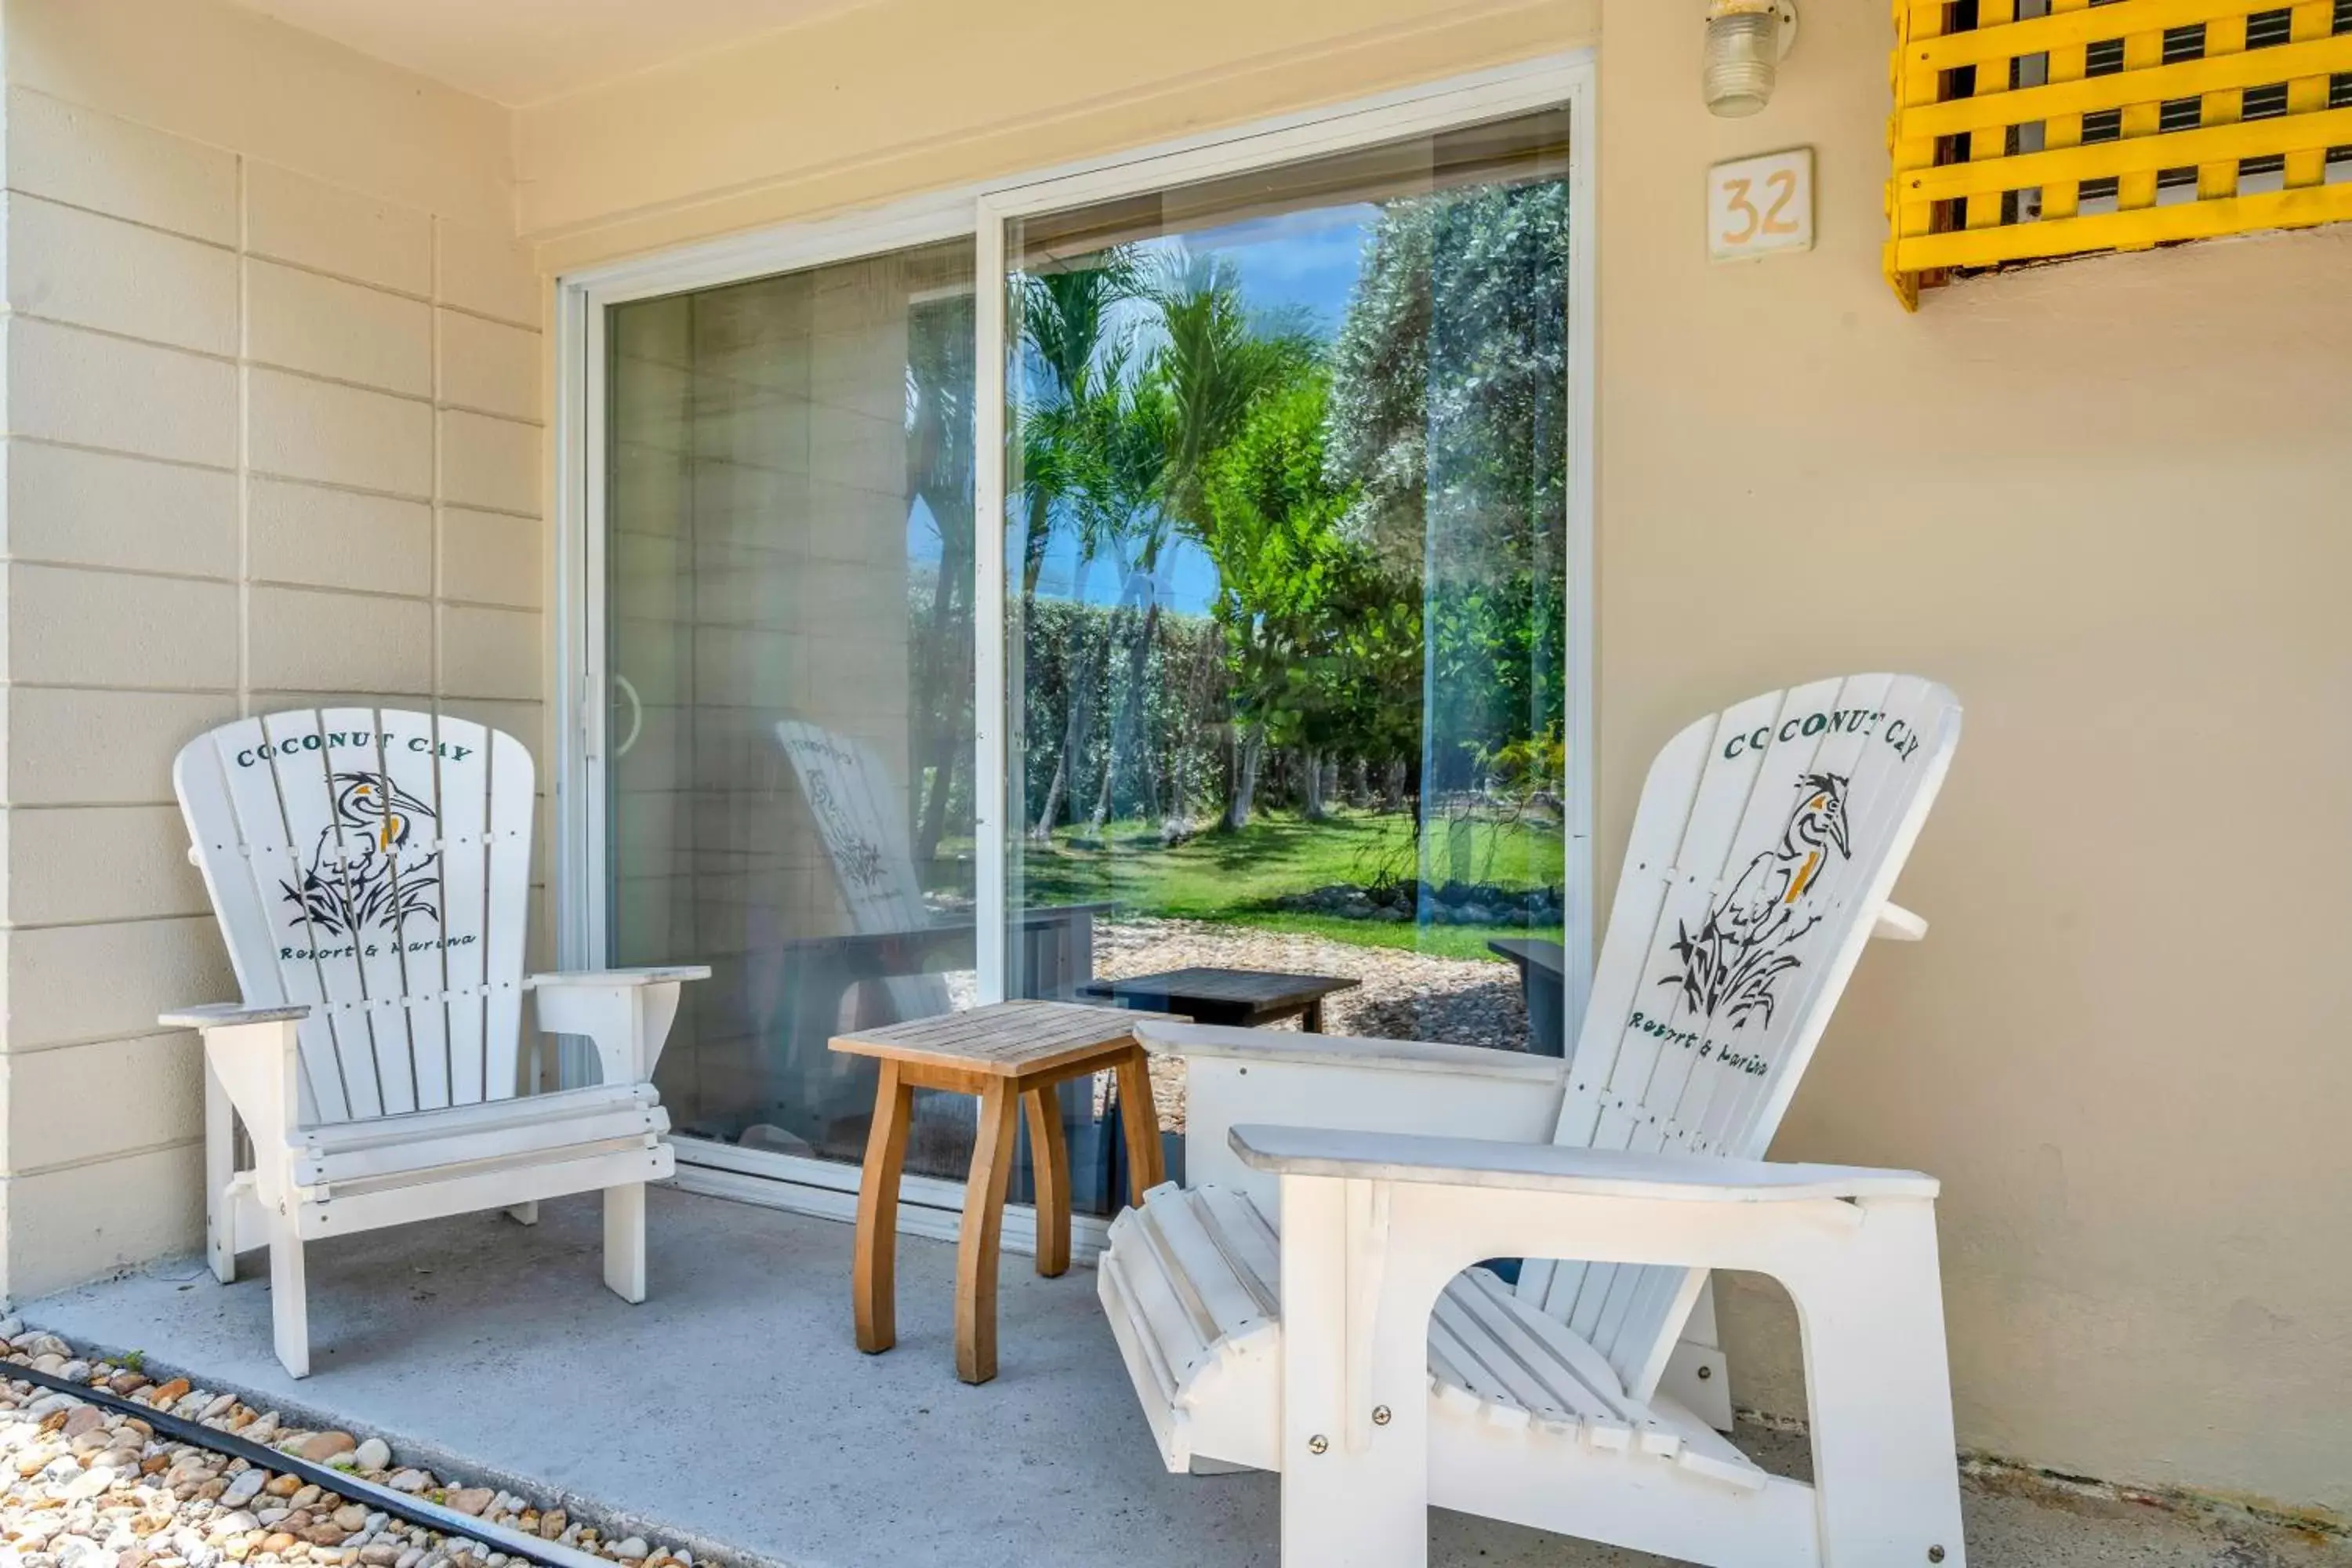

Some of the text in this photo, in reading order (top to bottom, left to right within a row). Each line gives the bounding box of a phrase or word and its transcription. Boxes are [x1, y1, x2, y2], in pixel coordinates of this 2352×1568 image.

[1722, 169, 1798, 244] 32
[237, 731, 394, 768] COCONUT
[281, 946, 356, 960] Resort
[365, 945, 379, 956] &
[1700, 1040, 1712, 1057] &
